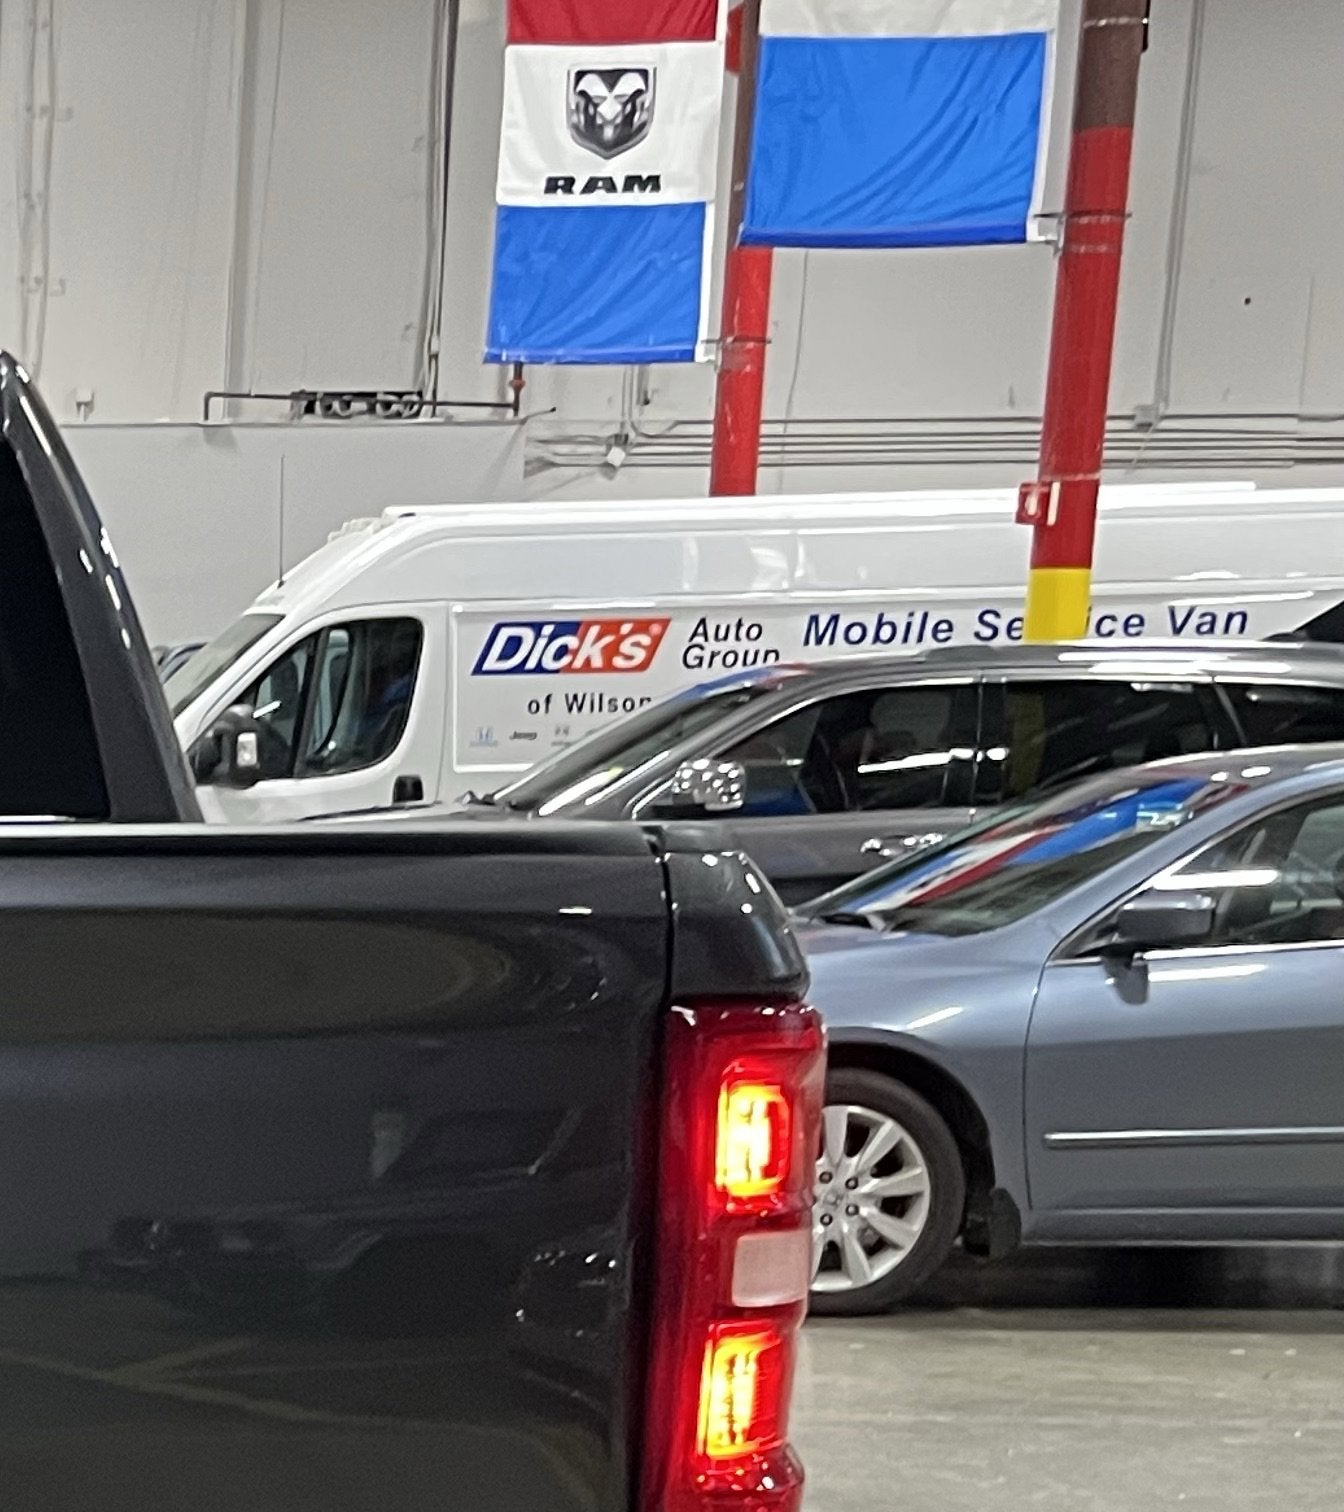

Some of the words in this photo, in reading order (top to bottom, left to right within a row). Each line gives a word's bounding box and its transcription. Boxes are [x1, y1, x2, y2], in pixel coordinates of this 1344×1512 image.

[544, 174, 661, 195] RAM
[803, 611, 954, 646] Mobile
[974, 606, 1145, 642] Seice
[1168, 605, 1248, 636] Van
[480, 623, 654, 672] Dick's
[687, 617, 763, 643] Auto
[527, 694, 552, 715] of
